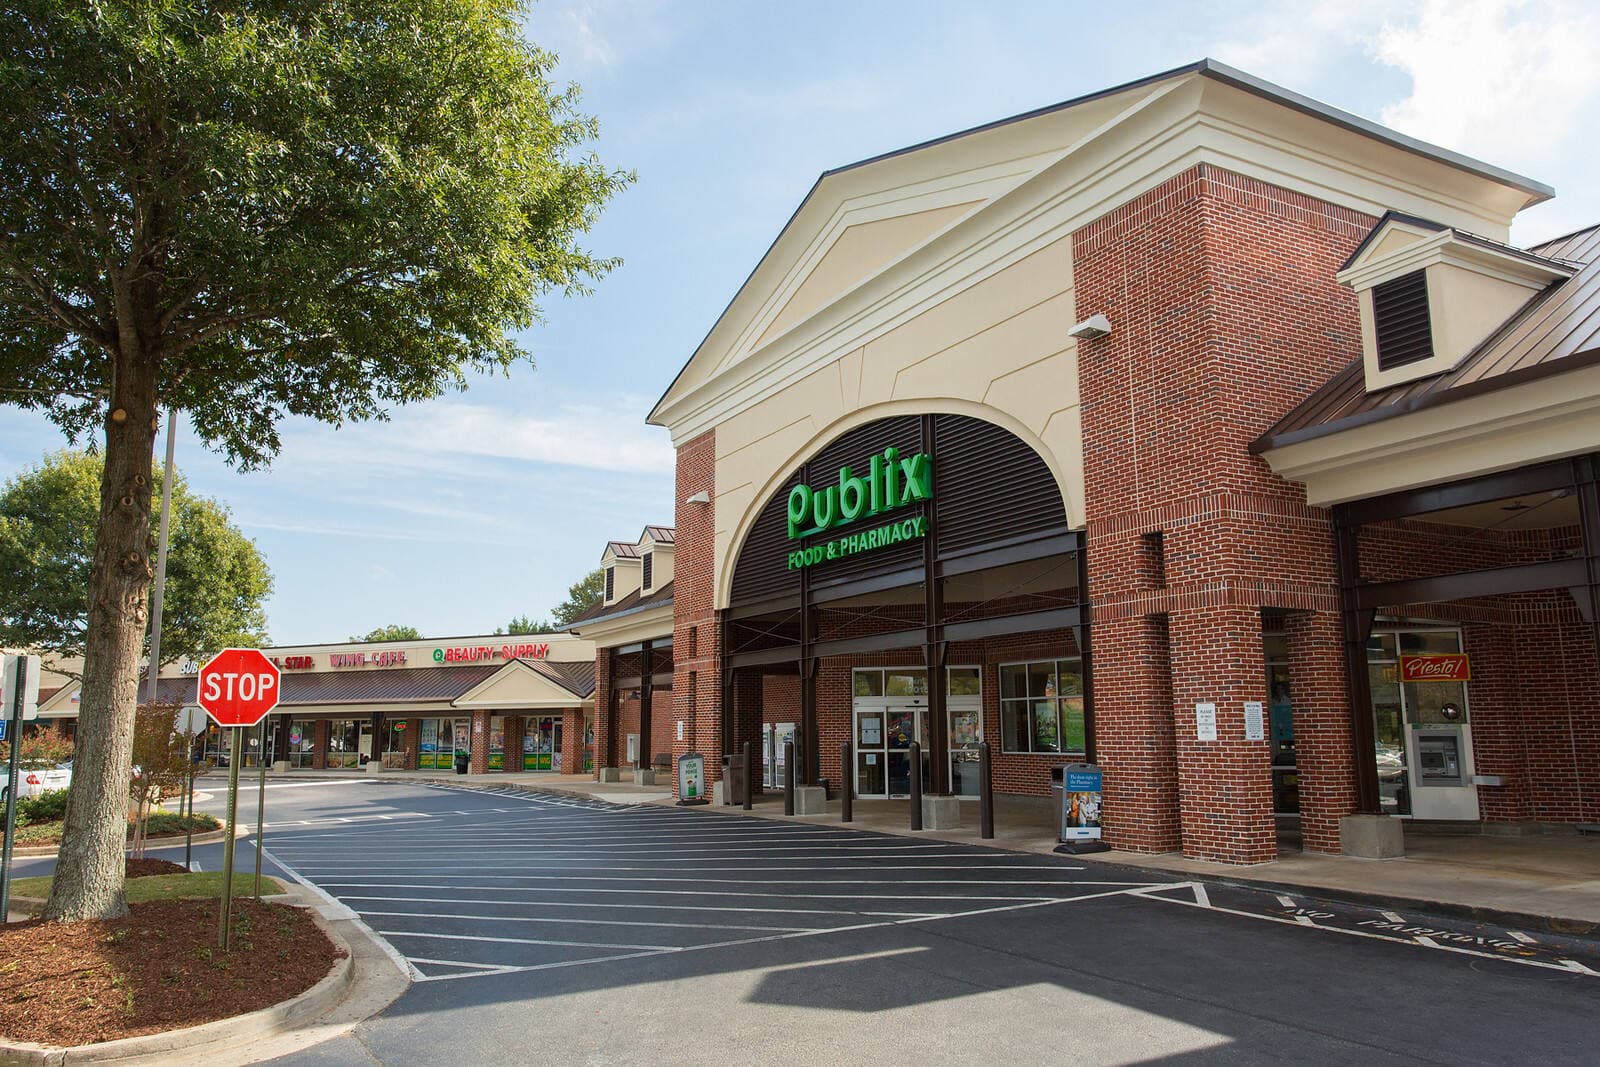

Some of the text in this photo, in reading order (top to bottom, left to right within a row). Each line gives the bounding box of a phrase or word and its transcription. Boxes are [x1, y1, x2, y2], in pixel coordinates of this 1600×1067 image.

[788, 447, 928, 540] Publix
[788, 517, 925, 570] FOOD & PHARMACY
[285, 656, 313, 670] STAR
[329, 651, 407, 668] WING CAFE
[445, 647, 494, 662] BEAUTY
[501, 643, 549, 660] SUPPLY
[1405, 659, 1464, 678] Presto!
[204, 673, 275, 701] STOP
[1285, 908, 1527, 949] NO PARKING
